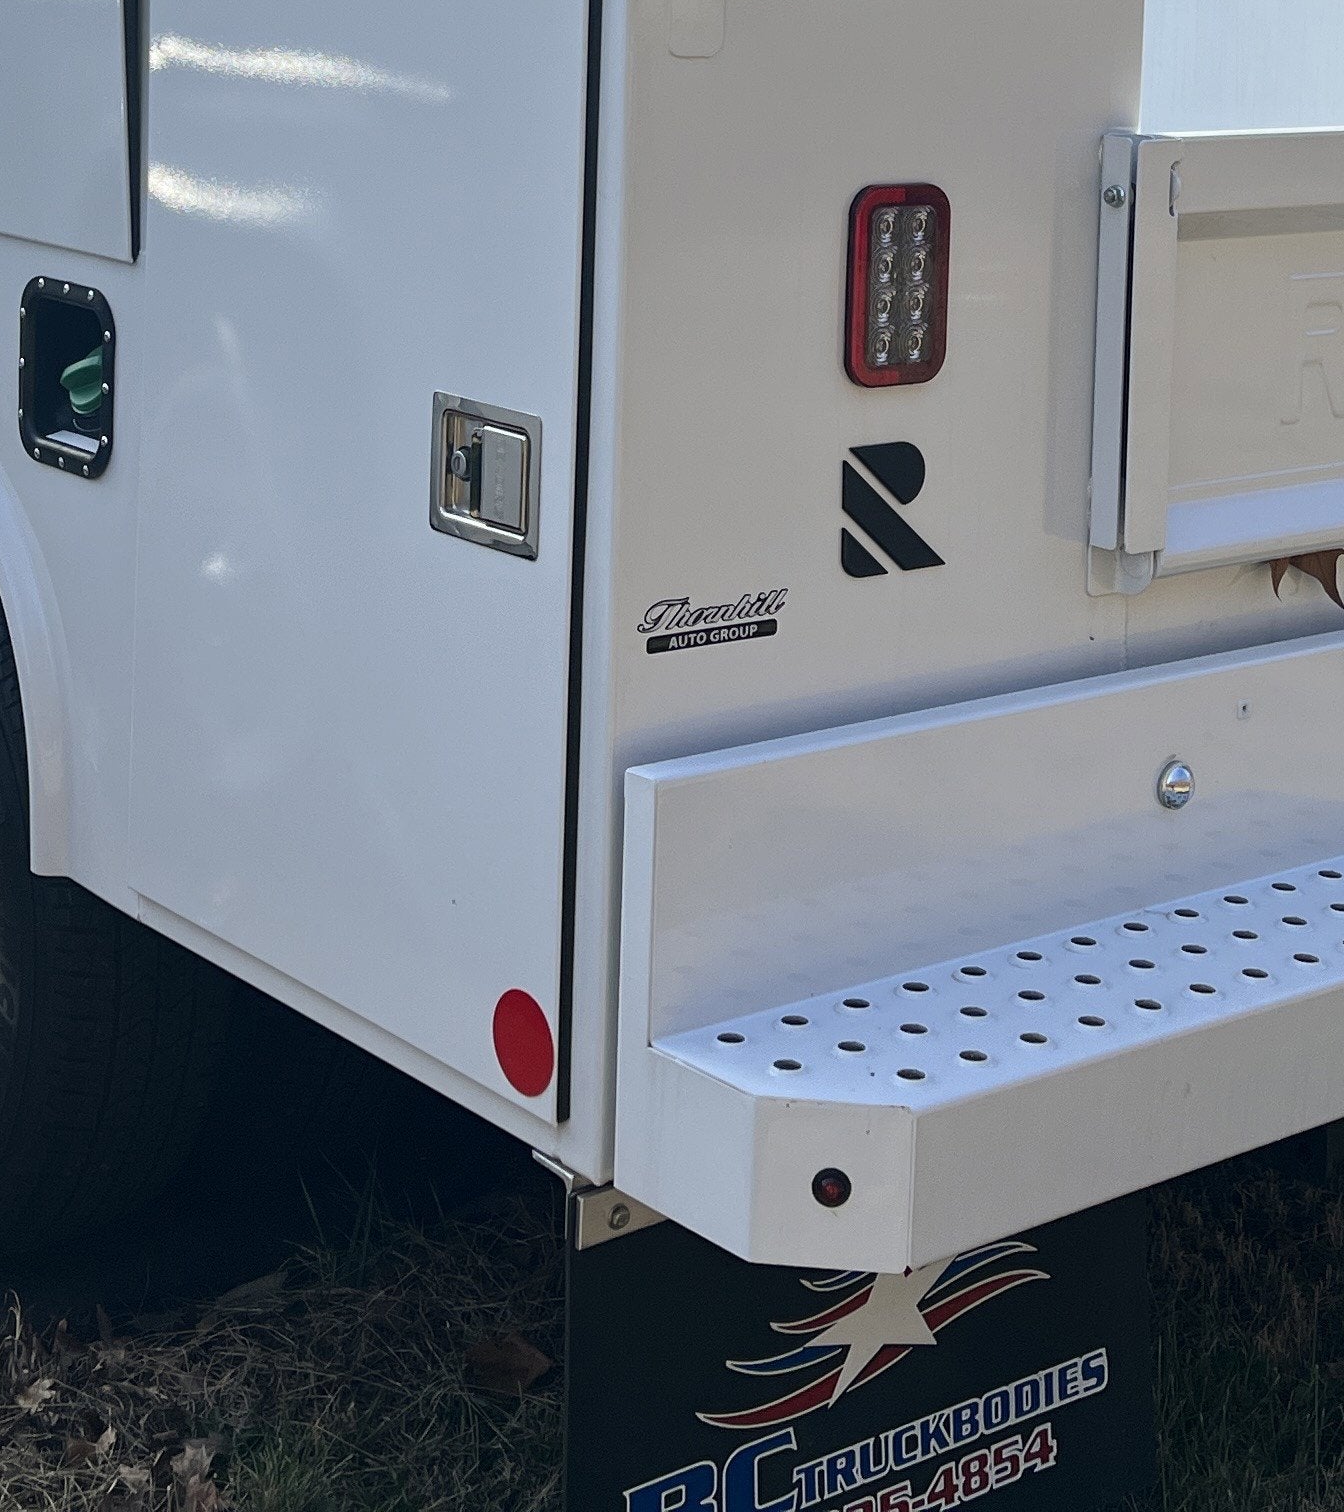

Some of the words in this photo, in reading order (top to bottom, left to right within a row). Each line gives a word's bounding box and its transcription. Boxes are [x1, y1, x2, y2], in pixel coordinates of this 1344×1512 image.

[637, 588, 789, 634] Thornhill
[668, 631, 707, 650] AUTO
[709, 623, 759, 643] GROUP
